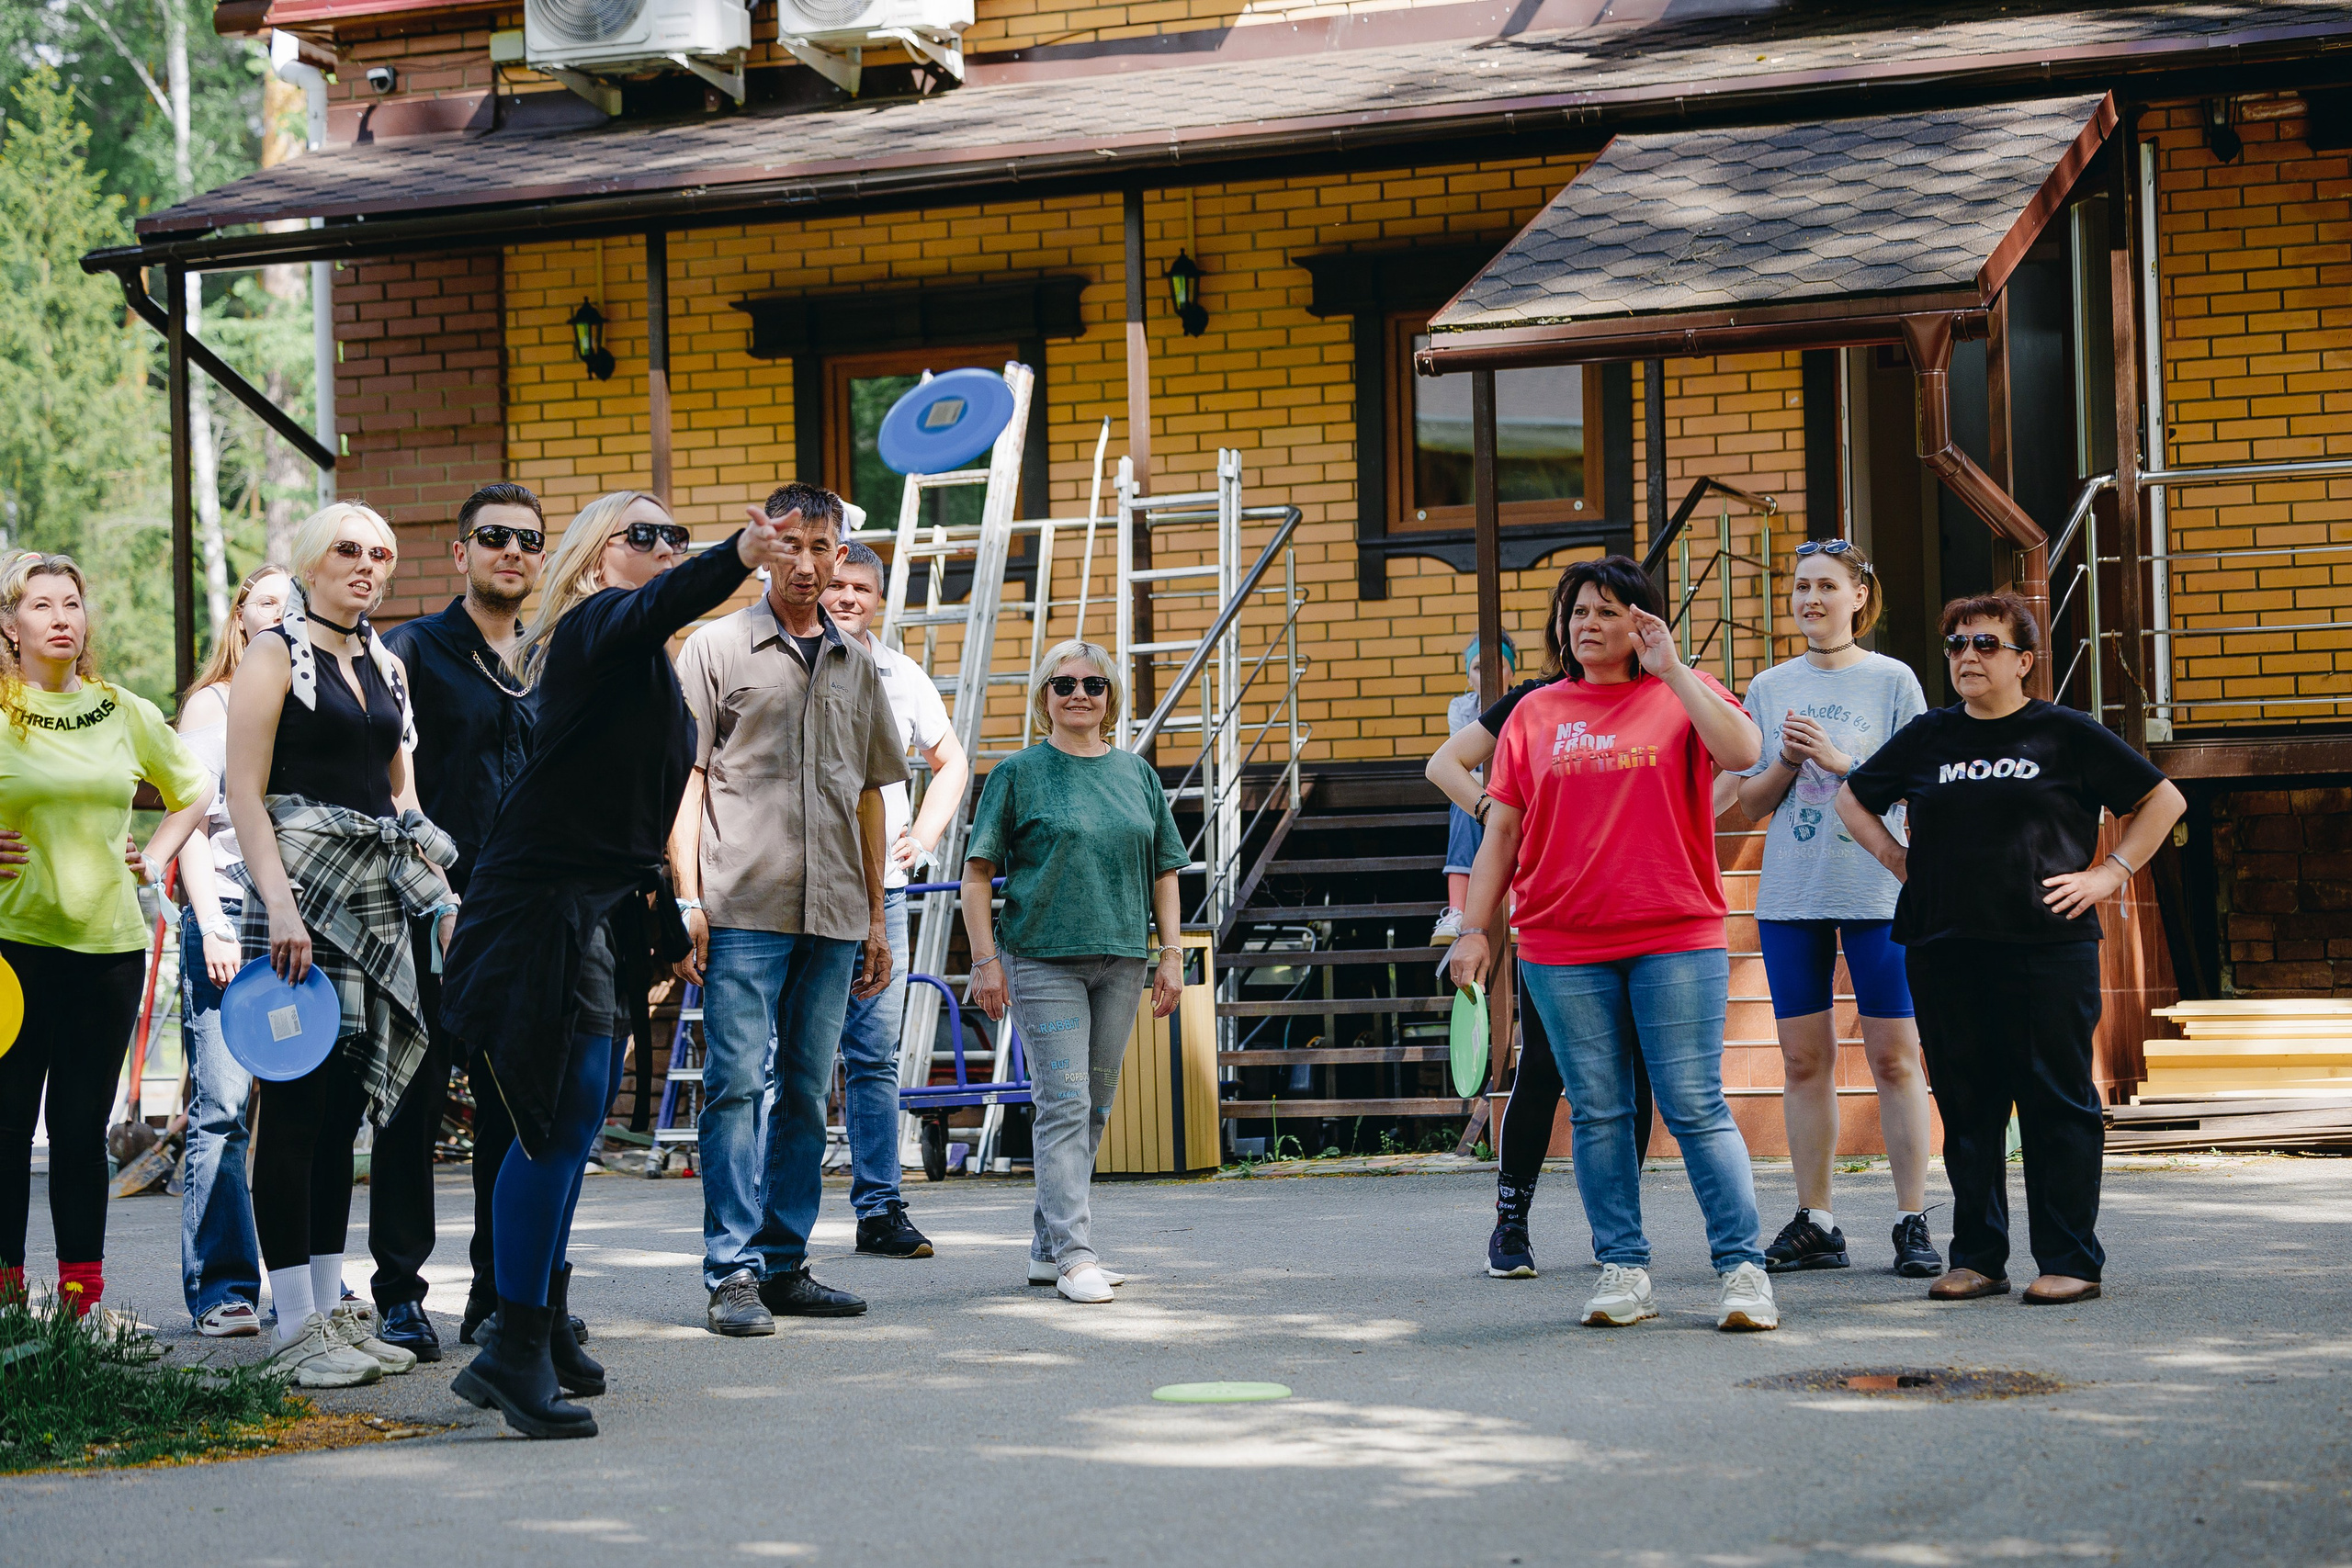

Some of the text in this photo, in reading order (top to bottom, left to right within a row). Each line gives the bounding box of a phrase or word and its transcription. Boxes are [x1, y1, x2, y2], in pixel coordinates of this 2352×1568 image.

[1556, 721, 1587, 740] NS
[1853, 716, 1871, 733] by
[1553, 735, 1616, 756] FROM
[1939, 758, 2040, 784] MOOD
[1039, 1017, 1080, 1034] RABBIT
[1050, 1058, 1069, 1070] BUT
